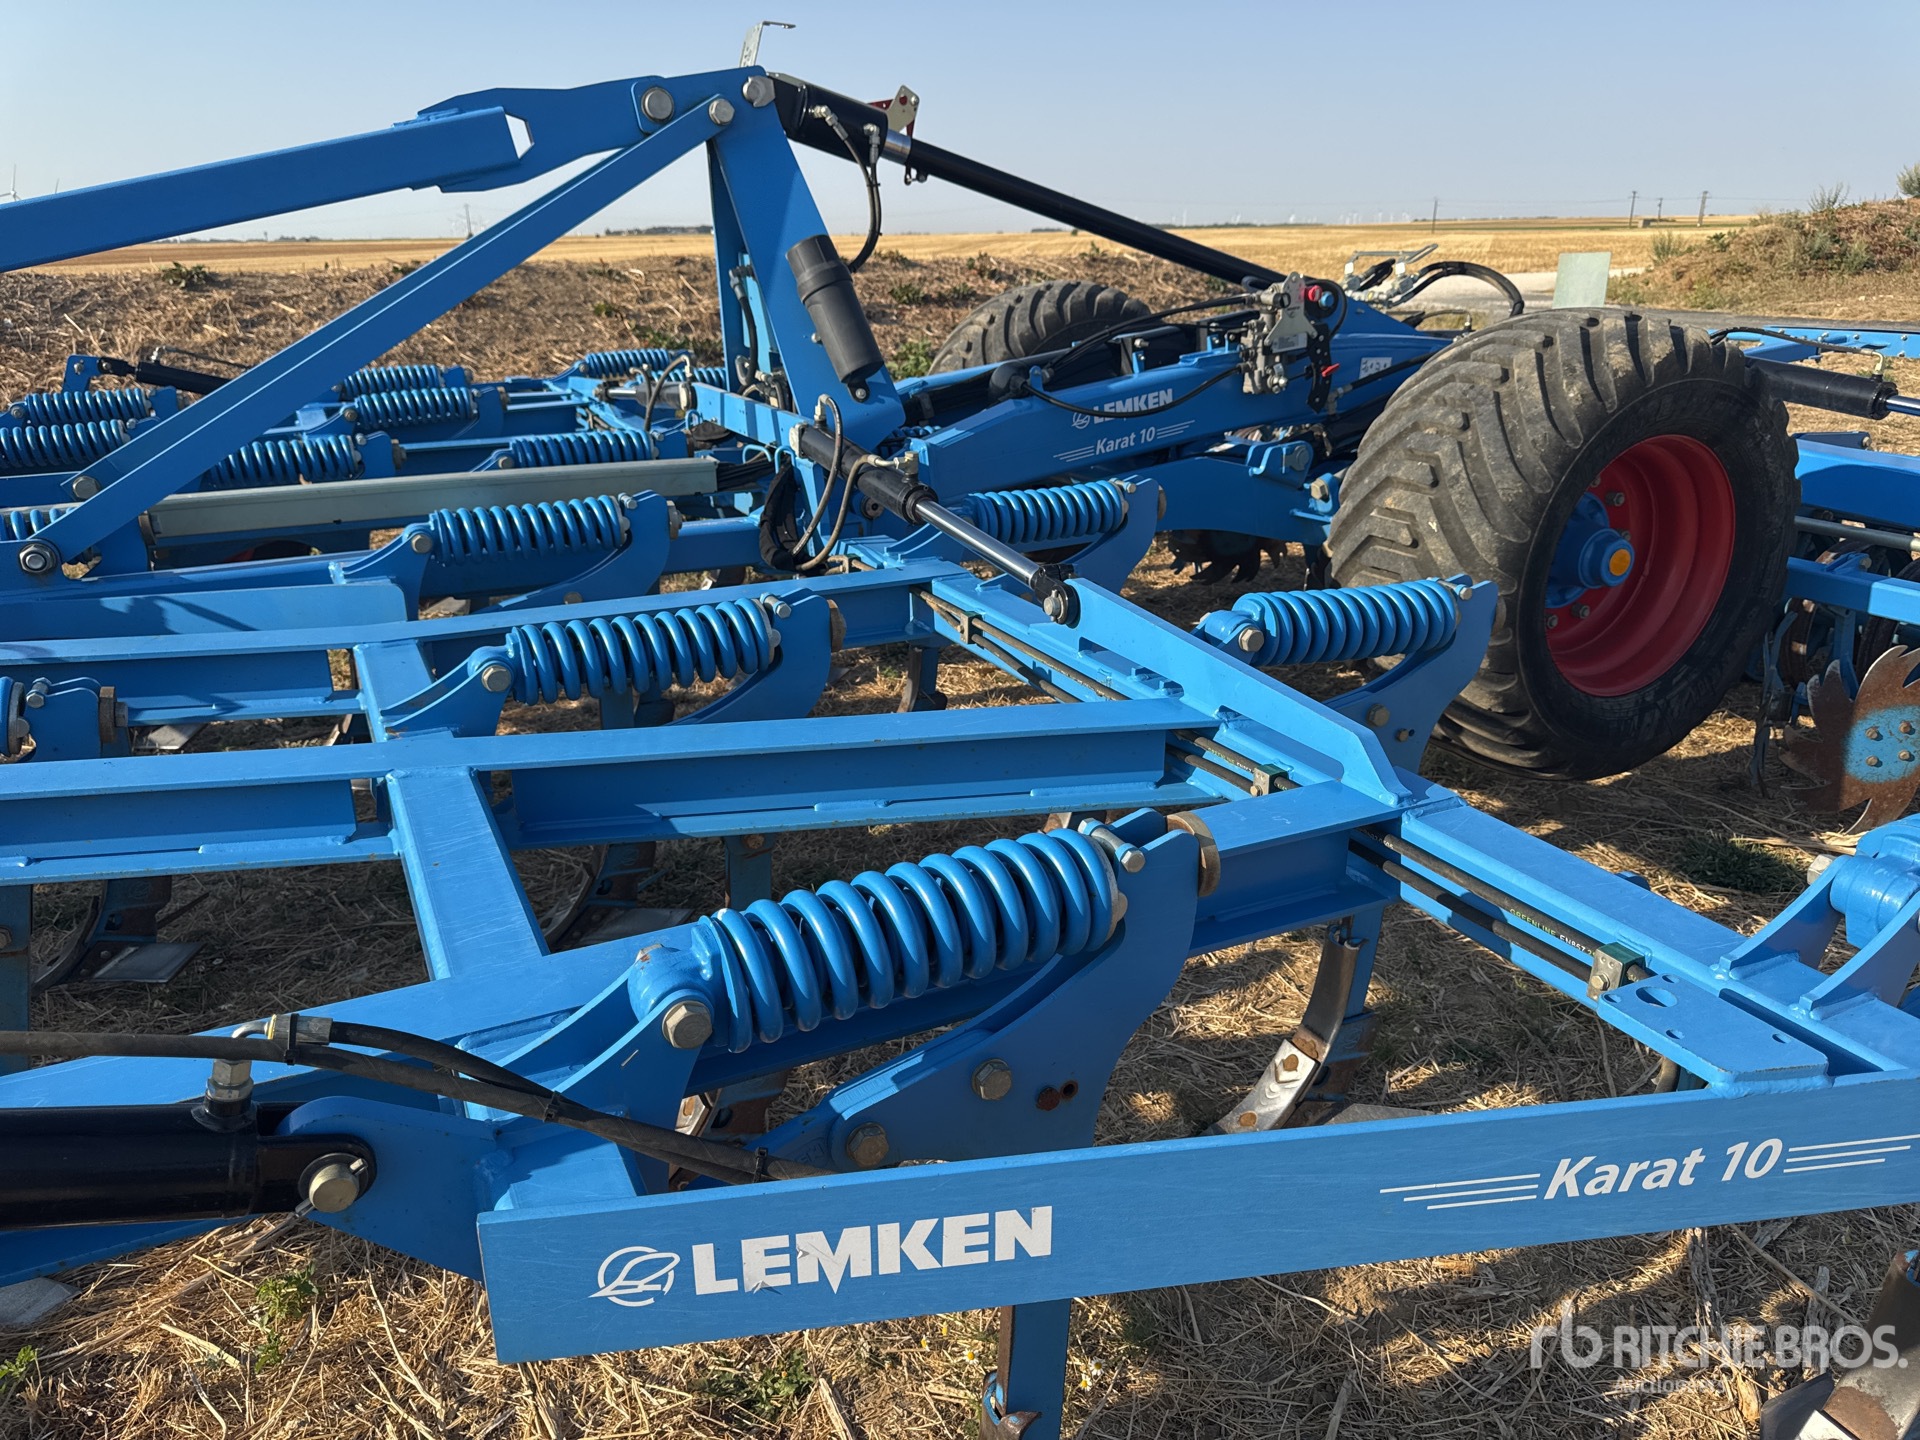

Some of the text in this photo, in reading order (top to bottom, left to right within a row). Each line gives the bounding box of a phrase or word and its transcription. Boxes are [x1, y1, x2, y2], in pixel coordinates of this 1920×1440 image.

[1093, 388, 1173, 424] LEMKEN
[1096, 426, 1156, 455] Karat 10
[1543, 1138, 1784, 1200] Karat 10
[692, 1205, 1053, 1296] LEMKEN
